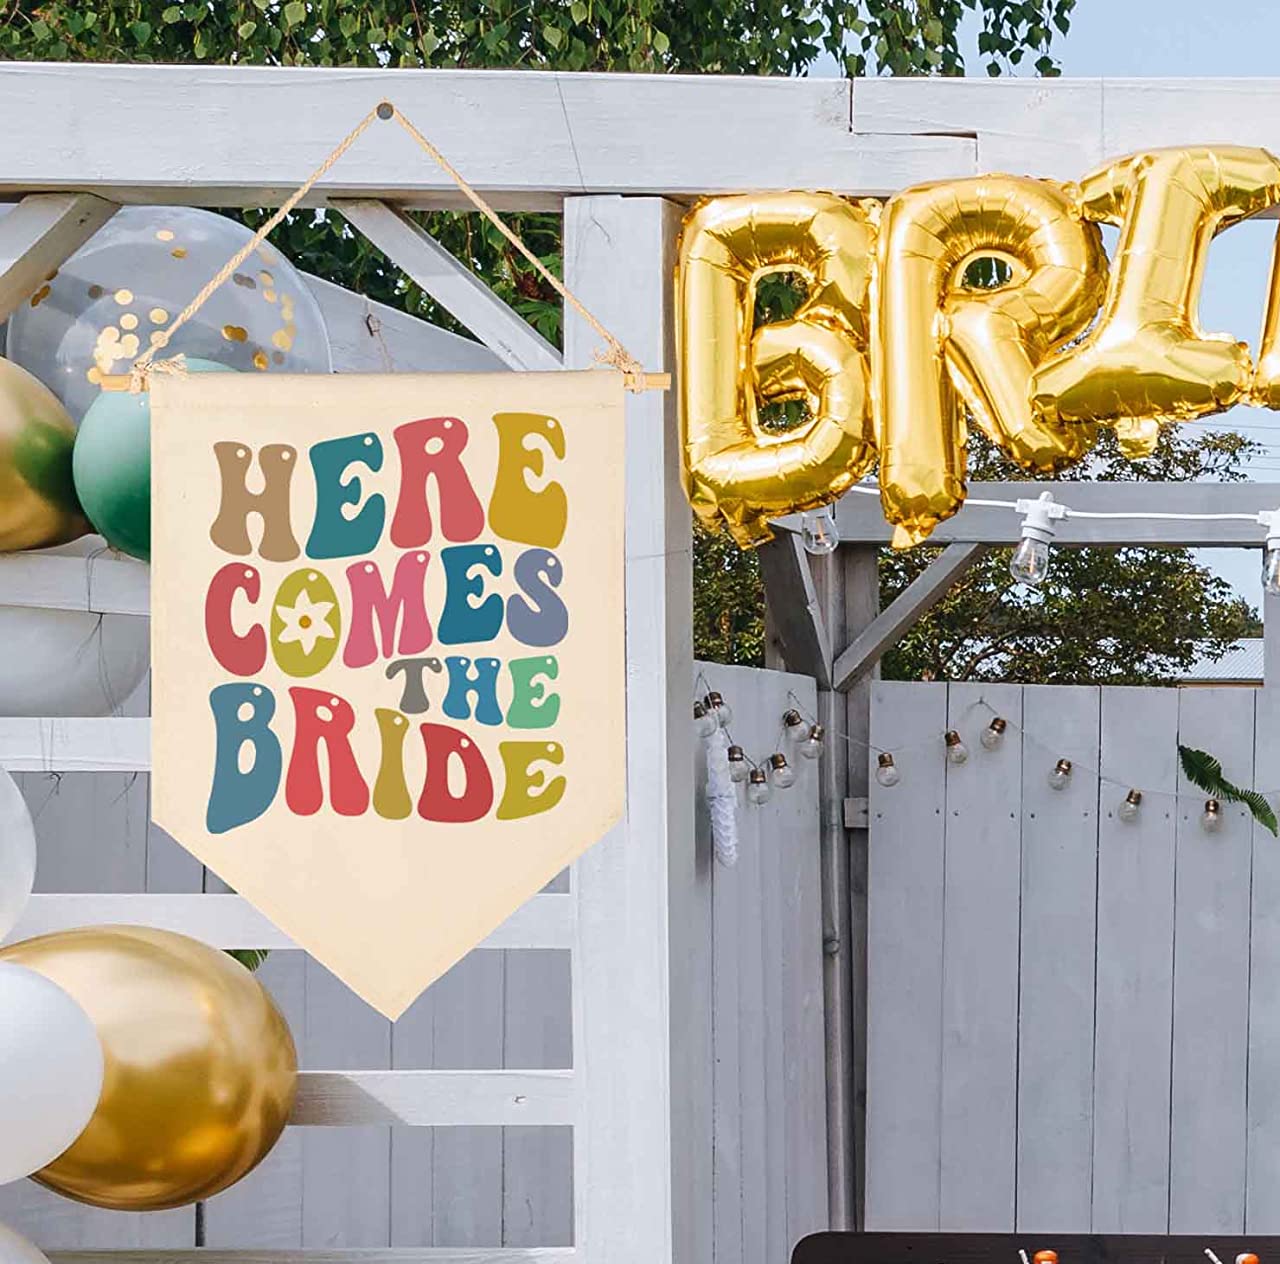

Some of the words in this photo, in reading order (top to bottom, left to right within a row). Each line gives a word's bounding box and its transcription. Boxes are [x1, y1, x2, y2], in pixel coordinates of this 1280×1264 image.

[209, 412, 568, 562] HERE
[205, 543, 569, 678] COMES
[206, 682, 567, 834] BRIDE
[386, 655, 559, 729] THE
